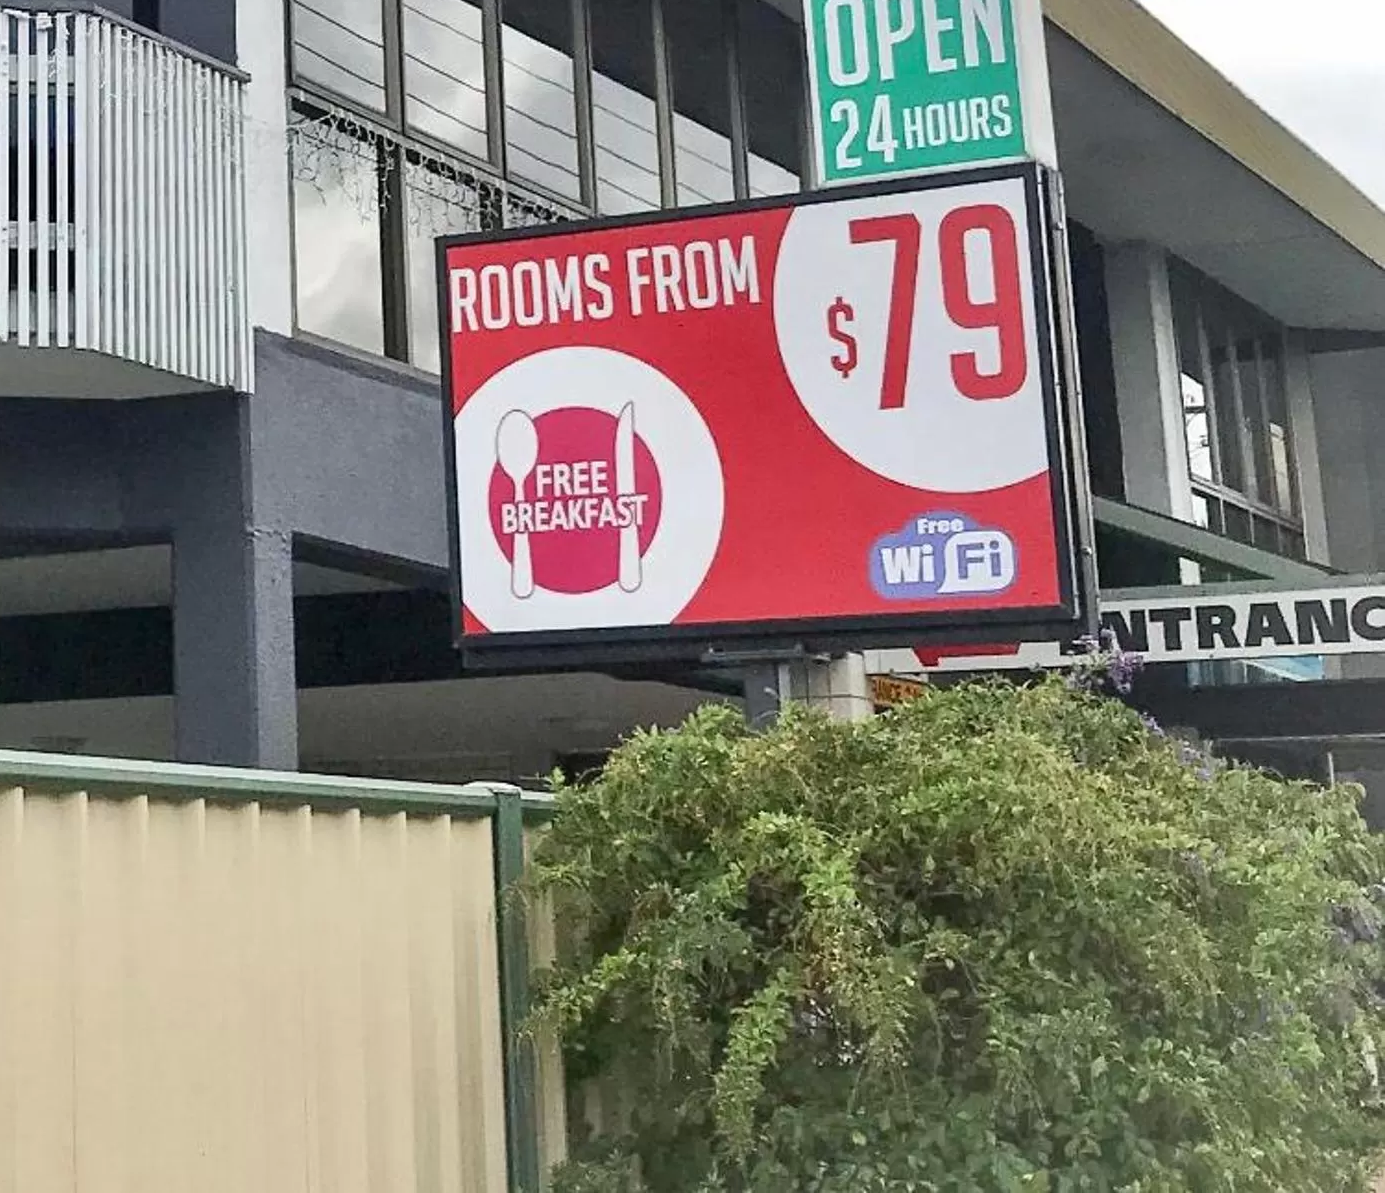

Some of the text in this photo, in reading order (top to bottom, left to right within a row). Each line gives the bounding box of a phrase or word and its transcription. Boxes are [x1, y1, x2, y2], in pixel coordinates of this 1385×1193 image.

[830, 94, 1012, 169] 24 HOURS
[450, 236, 761, 333] ROOMS FROM
[827, 204, 1027, 410] $79
[536, 461, 609, 498] FREE
[501, 494, 648, 535] BREAKFAST
[917, 517, 964, 535] Free
